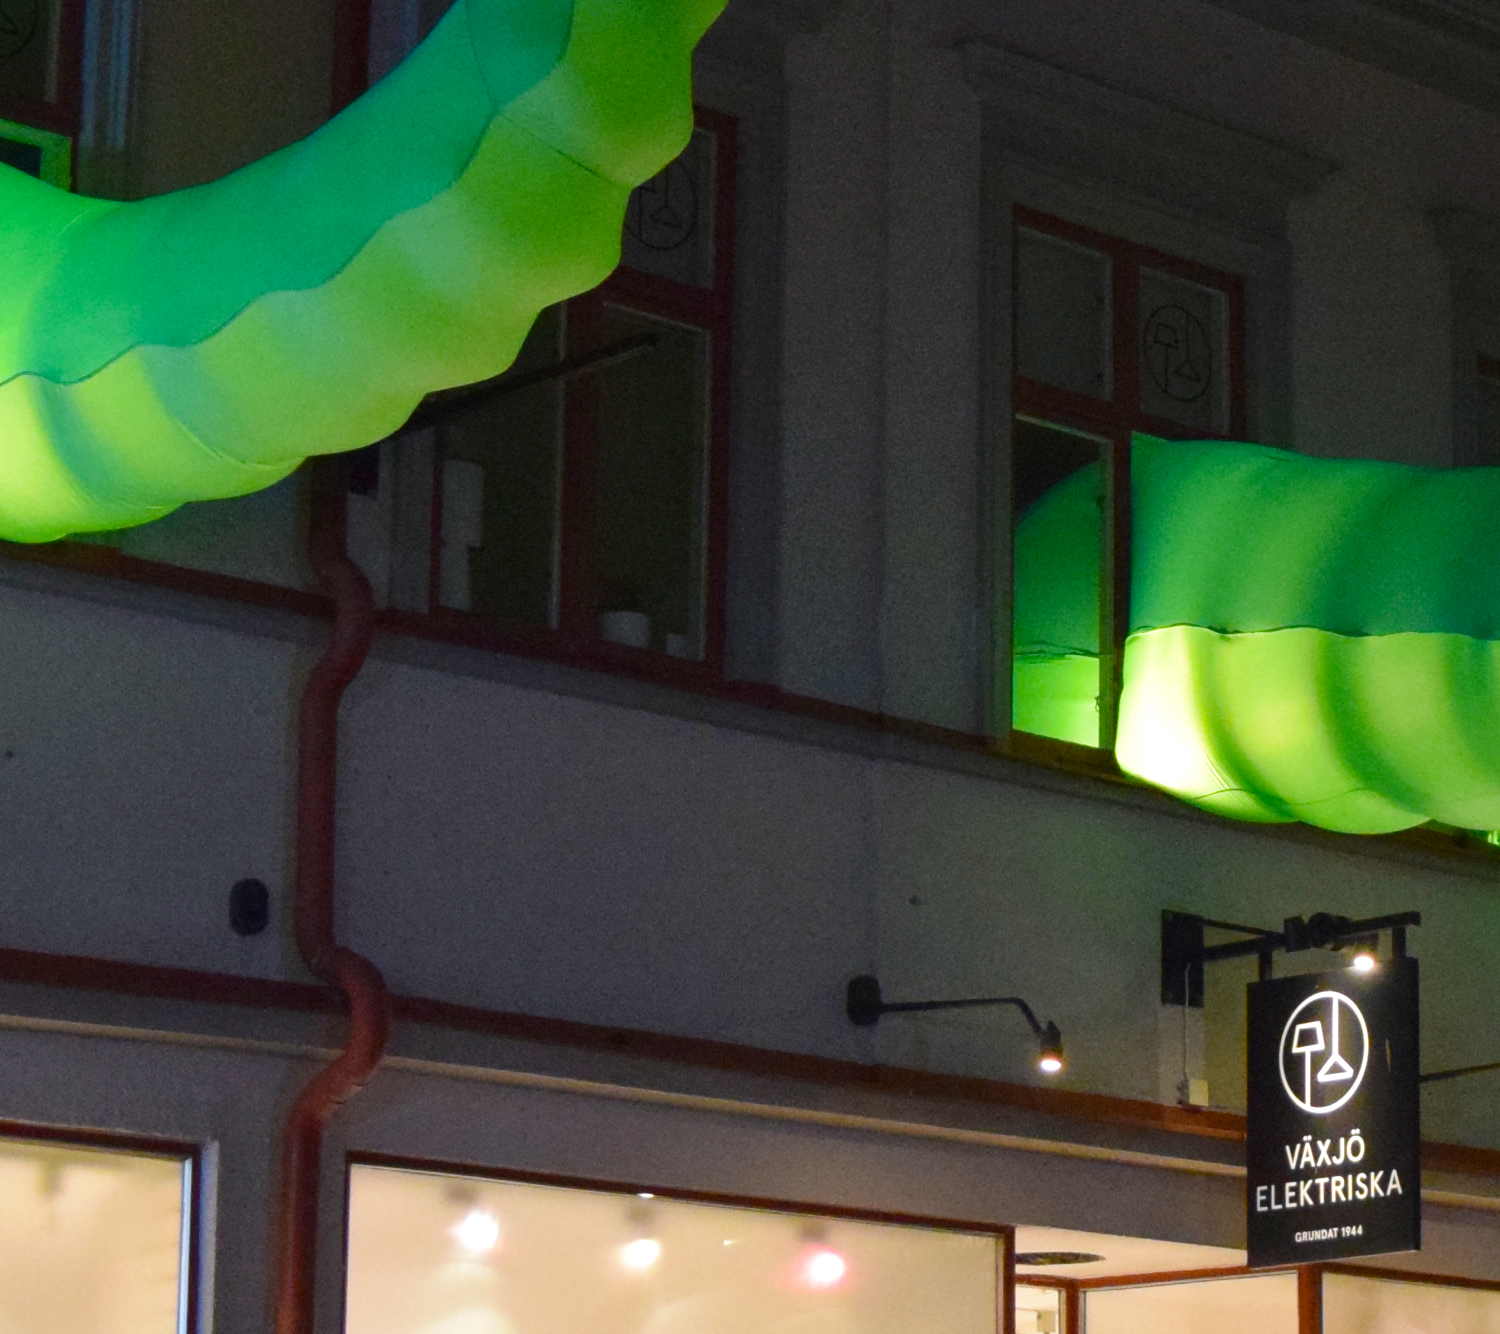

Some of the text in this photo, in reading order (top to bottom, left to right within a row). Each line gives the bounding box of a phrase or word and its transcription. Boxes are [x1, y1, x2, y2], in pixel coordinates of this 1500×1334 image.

[1285, 1128, 1365, 1170] VÄXJÖ
[1256, 1168, 1403, 1212] ELEKTRISKA
[1295, 1224, 1363, 1243] GRUNDAT 1944
